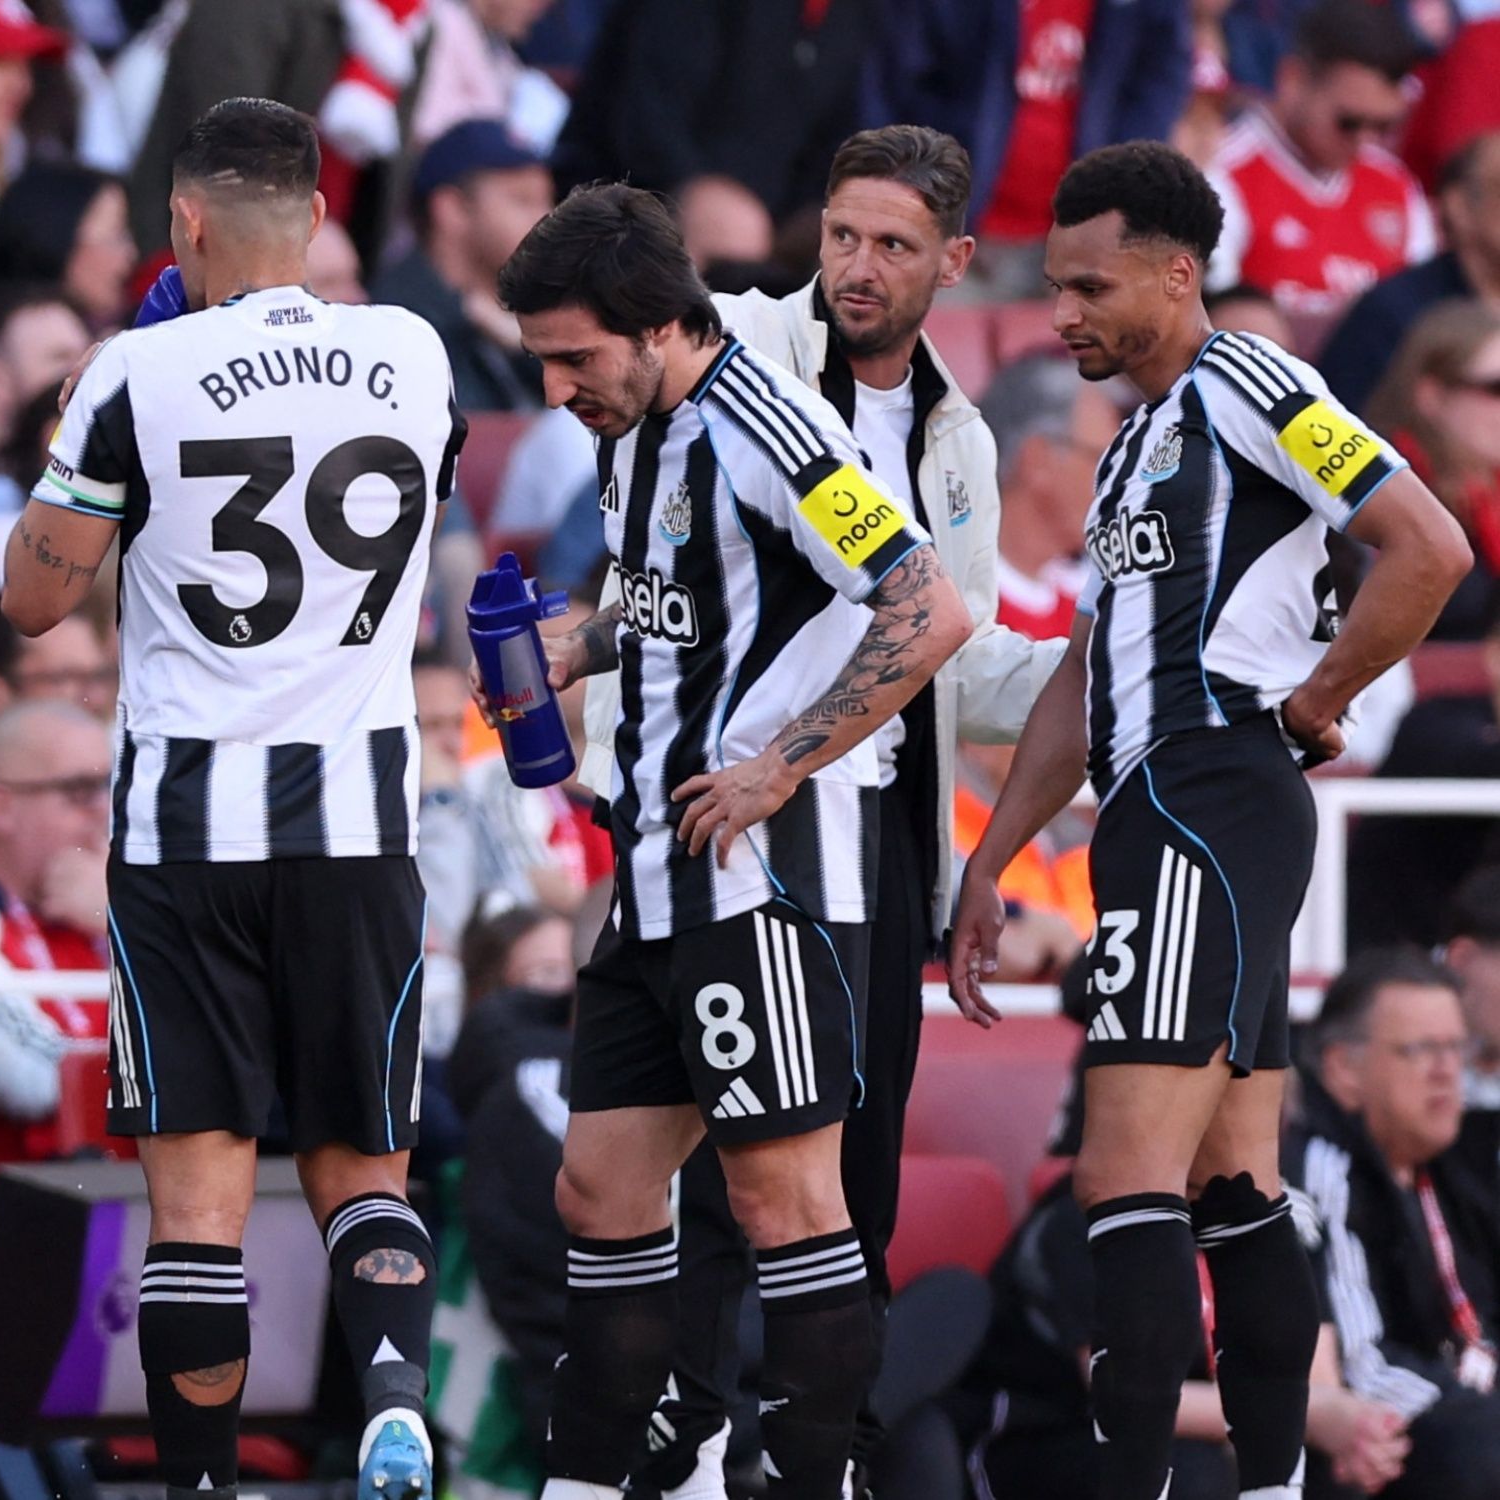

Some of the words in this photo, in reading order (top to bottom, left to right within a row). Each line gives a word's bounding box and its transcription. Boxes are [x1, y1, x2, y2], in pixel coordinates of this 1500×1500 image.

[264, 317, 284, 326] THE
[287, 314, 314, 325] LADS
[268, 306, 305, 318] HOWAY
[199, 347, 352, 413] BRUNO
[367, 361, 398, 410] G.
[1316, 433, 1369, 484] noon
[177, 435, 427, 648] 39
[836, 504, 895, 555] noon
[695, 982, 757, 1071] 8
